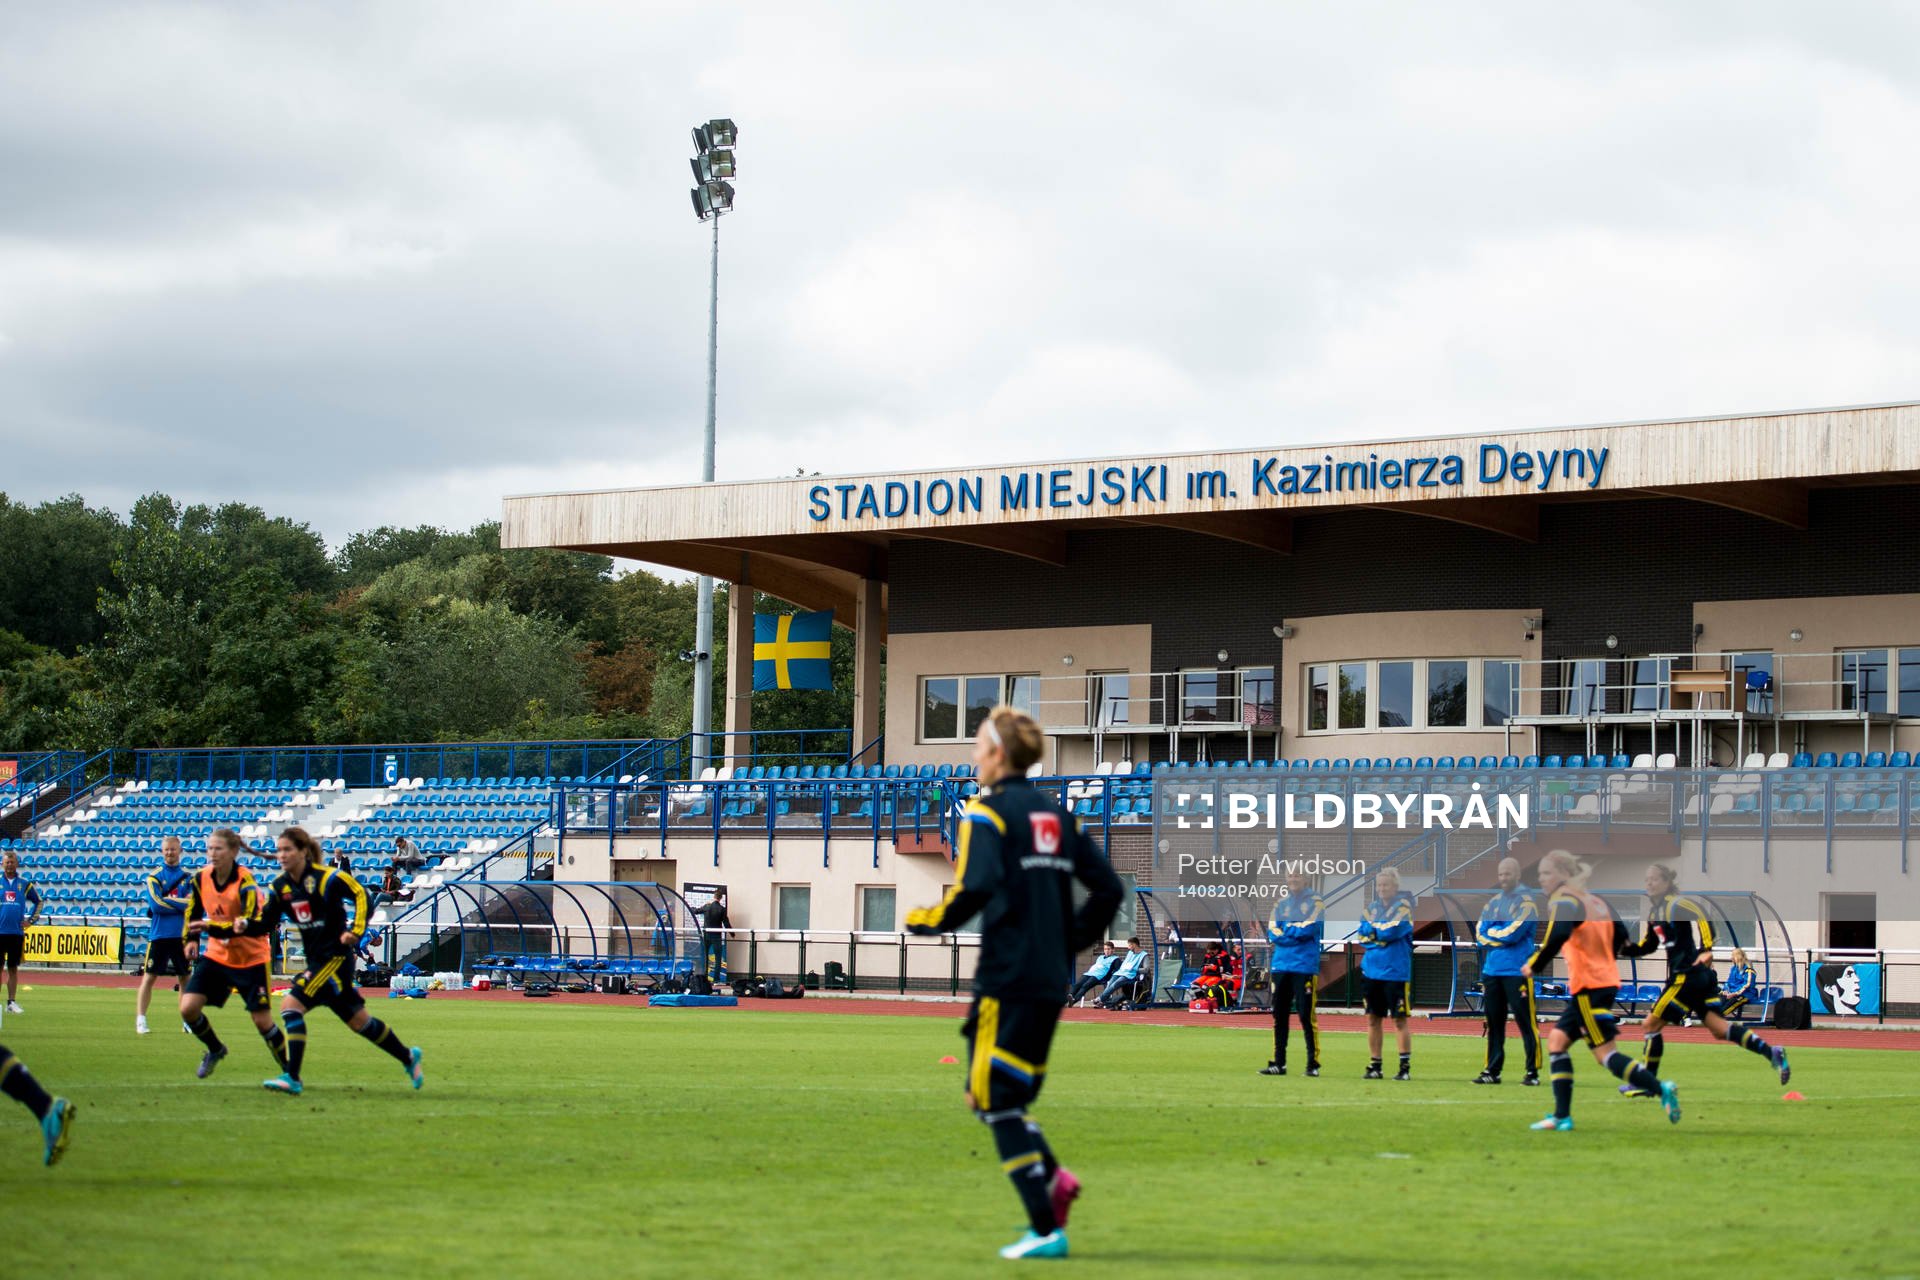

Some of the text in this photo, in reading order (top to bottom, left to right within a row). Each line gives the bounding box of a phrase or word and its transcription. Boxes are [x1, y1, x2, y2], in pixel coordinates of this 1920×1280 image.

[808, 476, 982, 521] STADION
[999, 463, 1167, 510] MIEJSKI
[1252, 453, 1463, 496] Kazimierza
[1478, 444, 1608, 490] Deyny
[385, 765, 395, 783] C
[57, 930, 108, 956] GDAŃSKI
